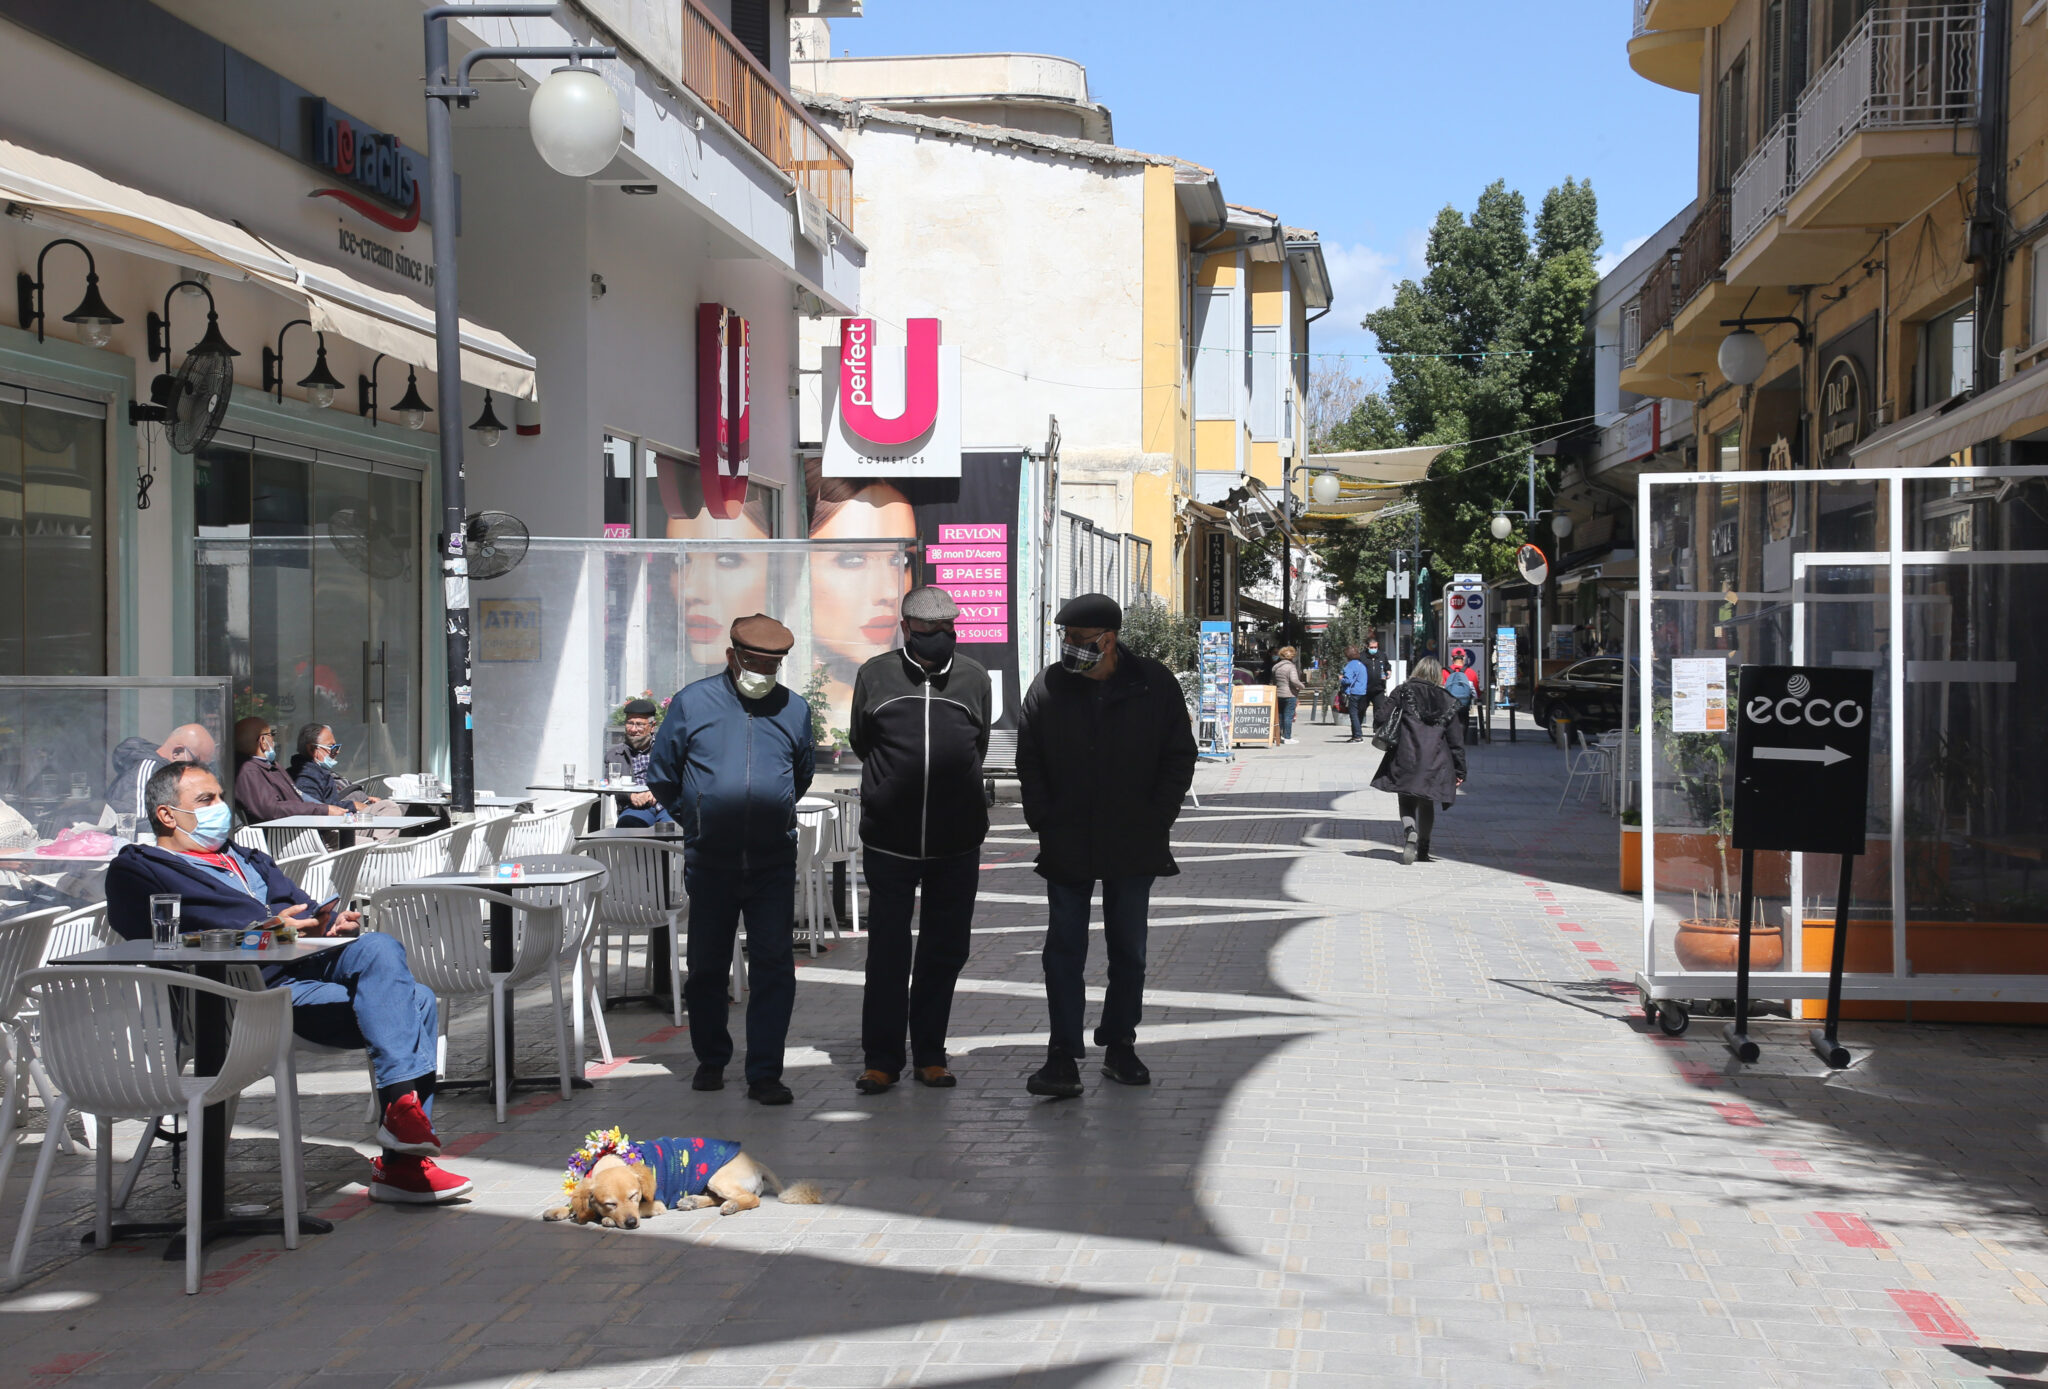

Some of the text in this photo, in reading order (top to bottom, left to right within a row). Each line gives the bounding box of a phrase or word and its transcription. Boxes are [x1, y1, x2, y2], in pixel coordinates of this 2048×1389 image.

[338, 217, 394, 270] ice-cream
[395, 245, 423, 282] since
[844, 323, 872, 406] perfect
[857, 456, 925, 464] COSMETICS
[945, 528, 1001, 540] REVLON
[965, 549, 1002, 558] D'Acero
[956, 568, 1002, 579] PAESE
[960, 606, 1002, 617] AYOT
[485, 611, 537, 628] ATM
[955, 629, 1003, 638] NS SOUCIS
[1746, 696, 1864, 728] ecco
[1234, 726, 1270, 735] CURTAINS
